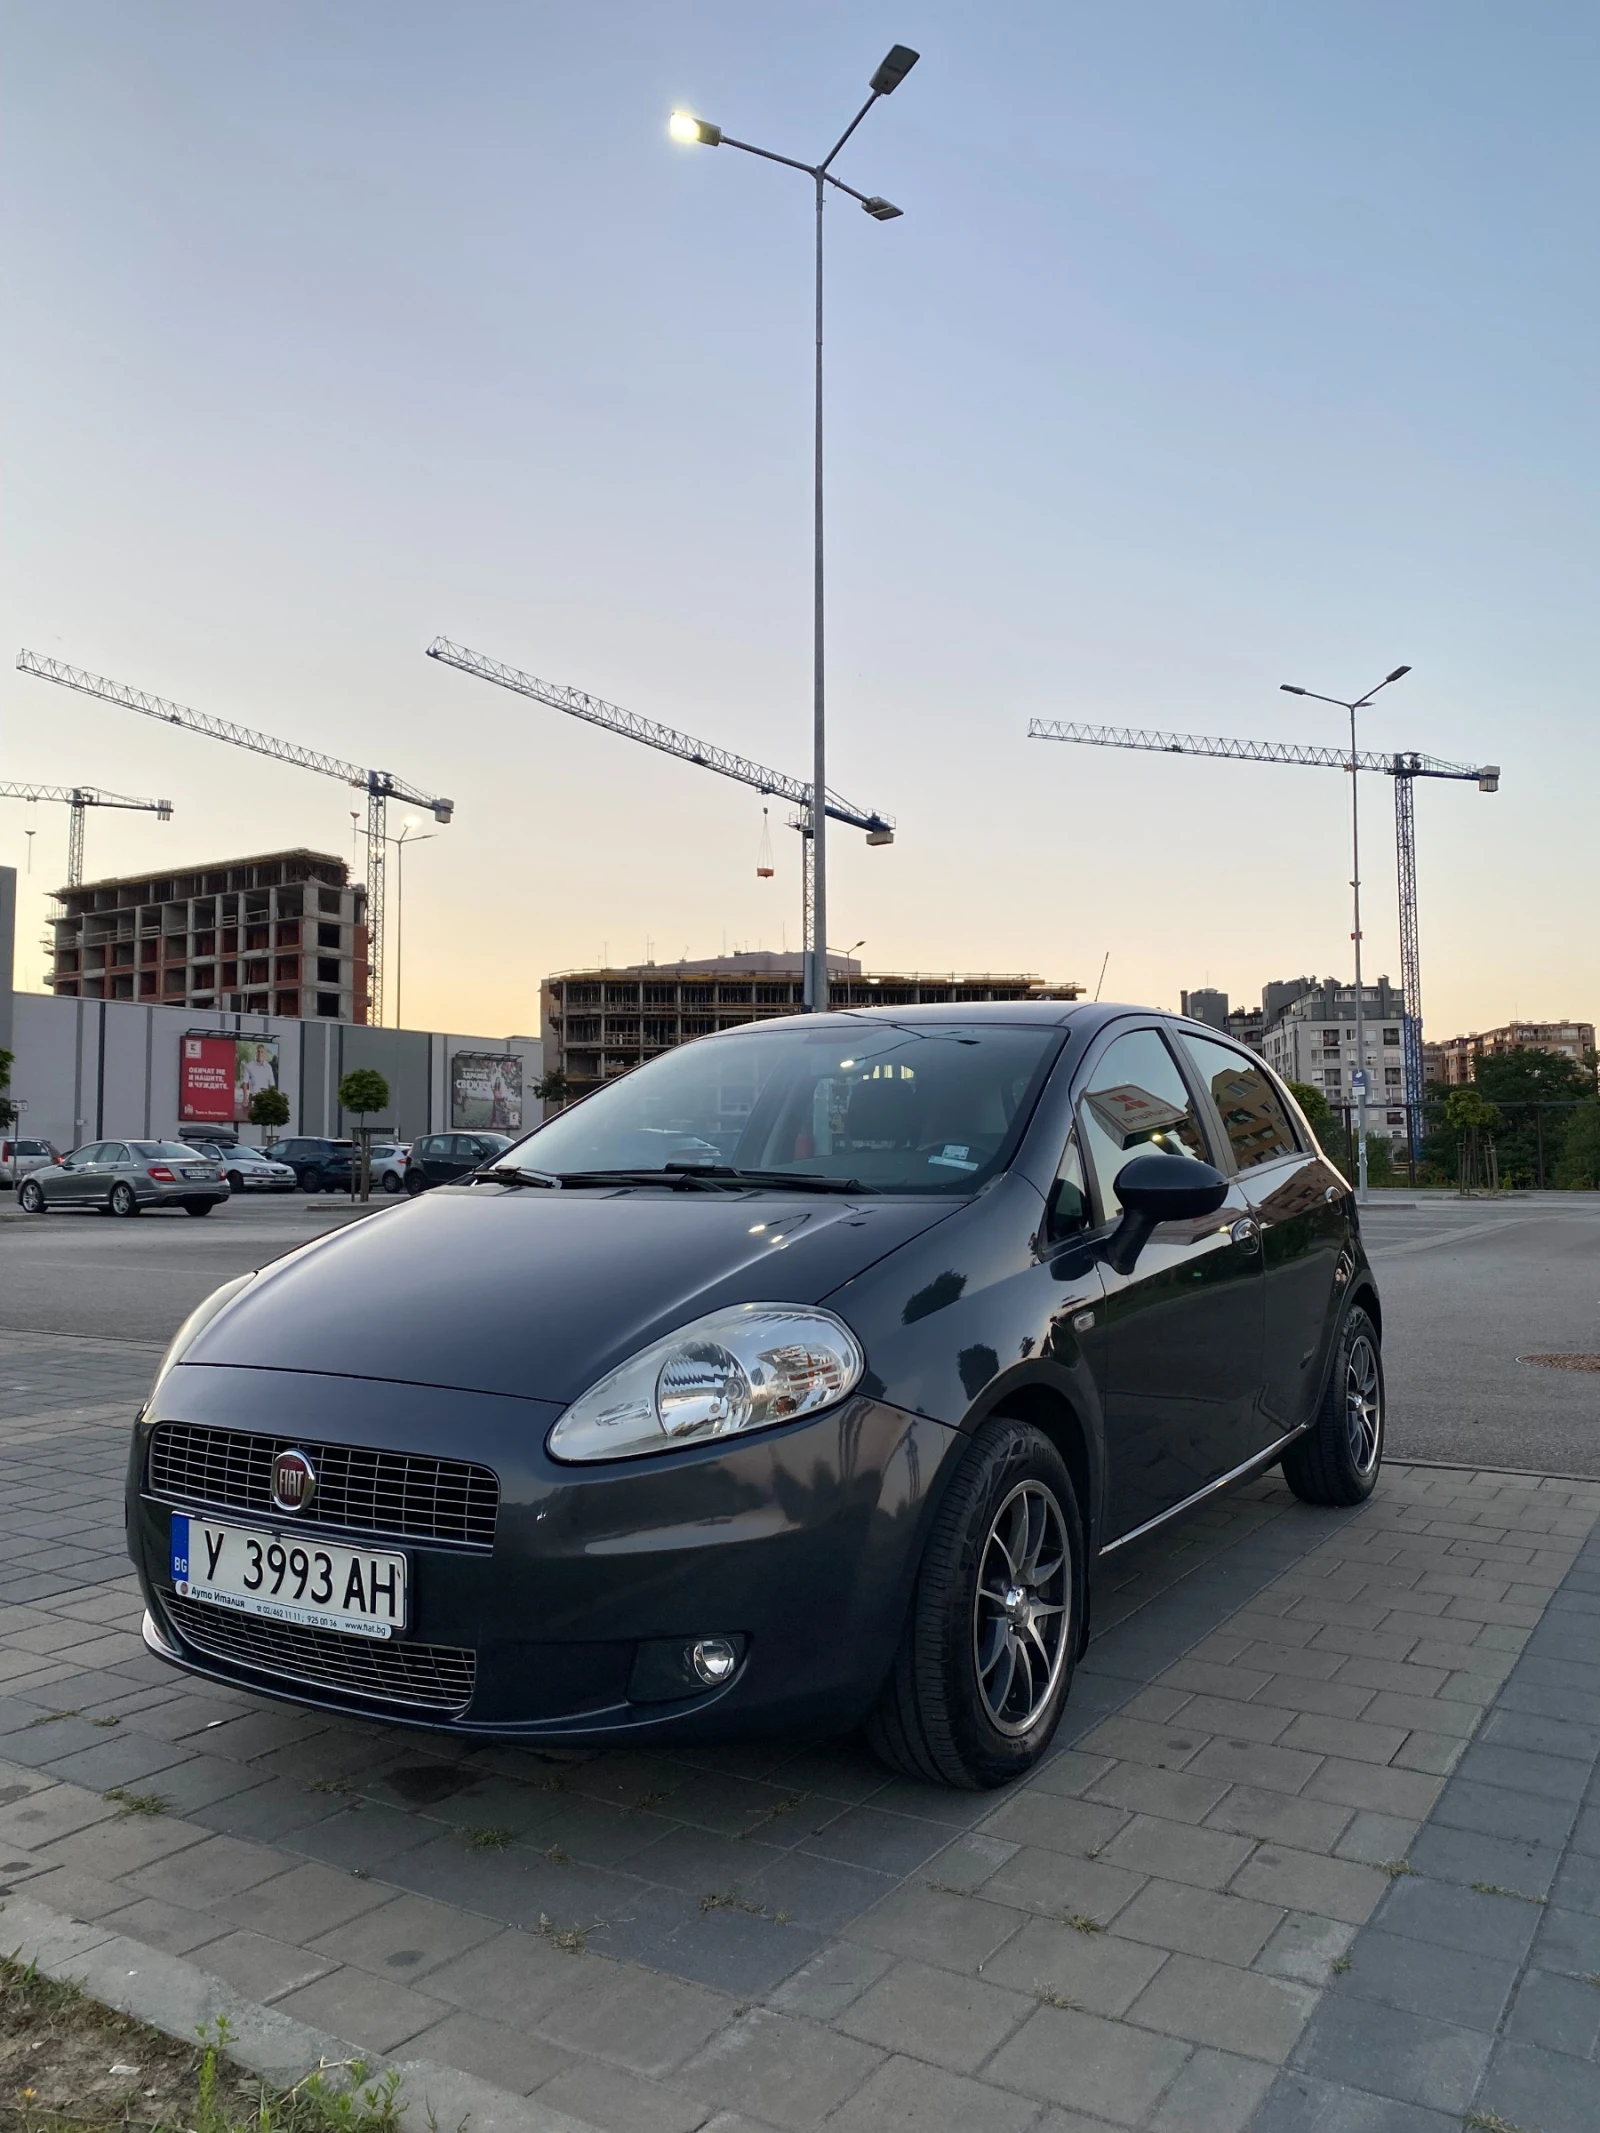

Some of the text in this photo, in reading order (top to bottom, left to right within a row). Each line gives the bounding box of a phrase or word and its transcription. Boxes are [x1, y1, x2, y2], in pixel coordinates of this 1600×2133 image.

[189, 1067, 215, 1075] ОБИЧАТ
[456, 1079, 490, 1089] СВЕЖЕС
[279, 1468, 305, 1497] FIAT
[173, 1556, 188, 1574] BG
[243, 1538, 333, 1604] 3993
[191, 1586, 245, 1608] Ауто Италия
[344, 1620, 386, 1637] www.fiat.bg
